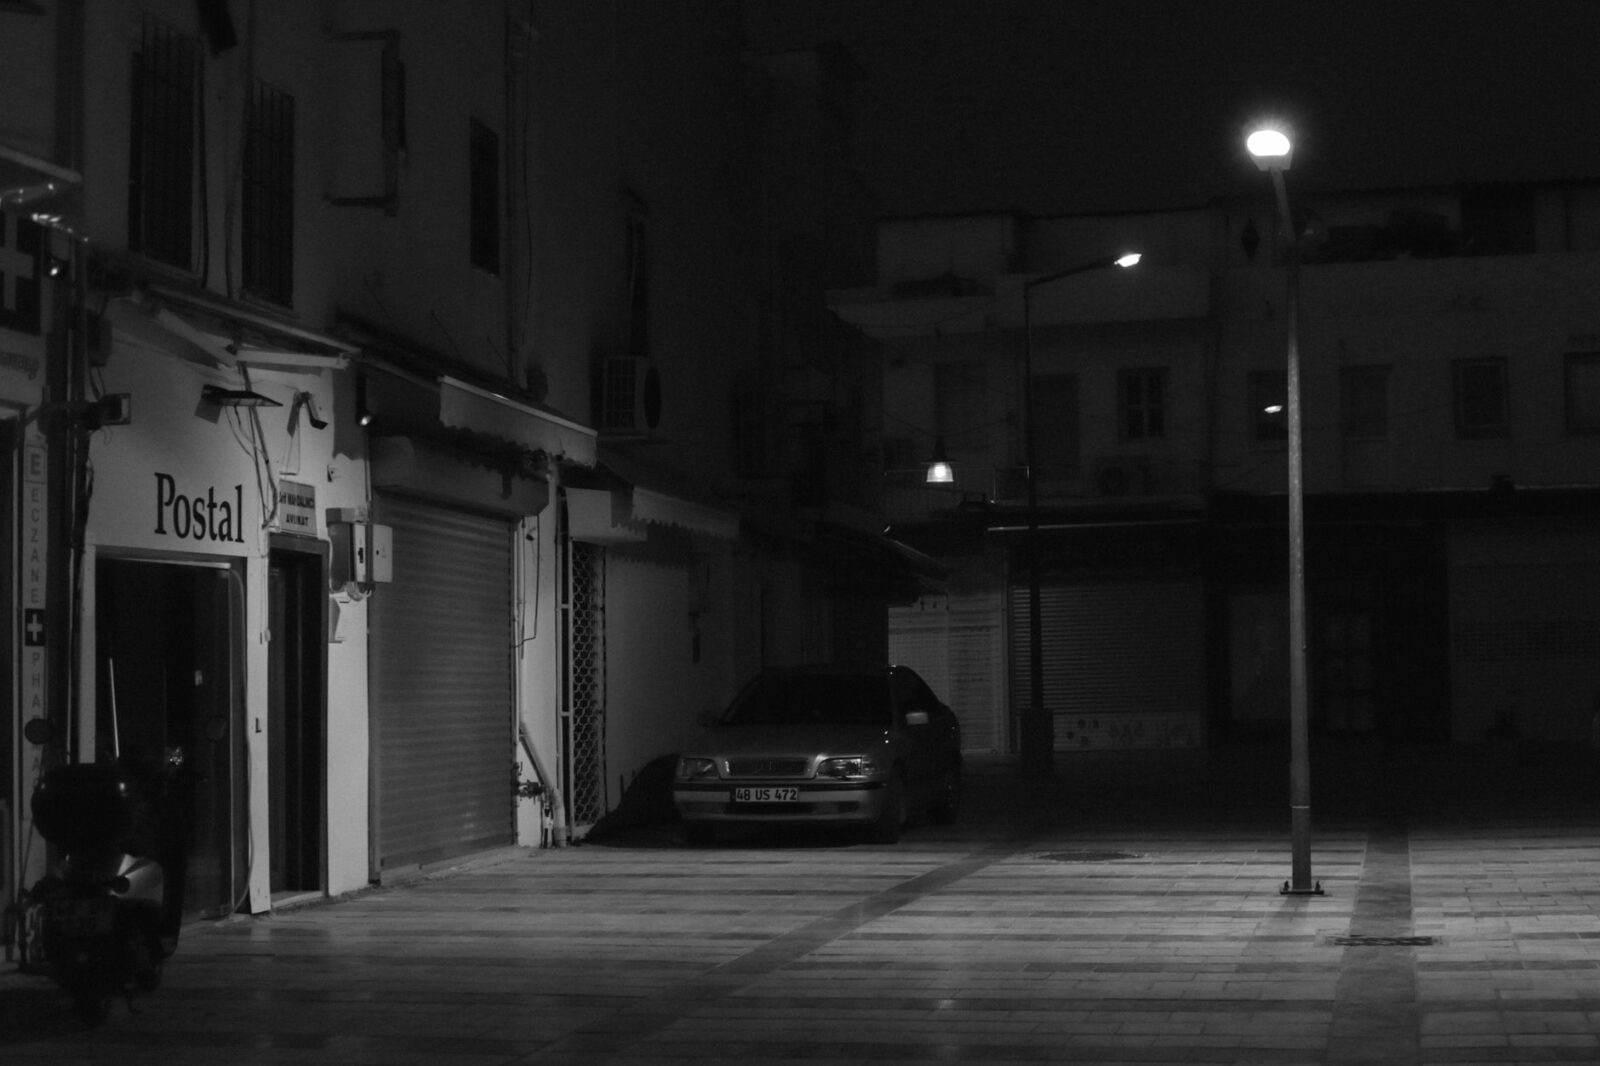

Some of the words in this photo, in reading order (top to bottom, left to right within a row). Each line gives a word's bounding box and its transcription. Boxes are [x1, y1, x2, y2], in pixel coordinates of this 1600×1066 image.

[154, 472, 244, 543] Postal
[31, 488, 40, 604] ECZANE
[736, 789, 751, 801] 48
[755, 789, 770, 801] US
[774, 789, 797, 801] 472
